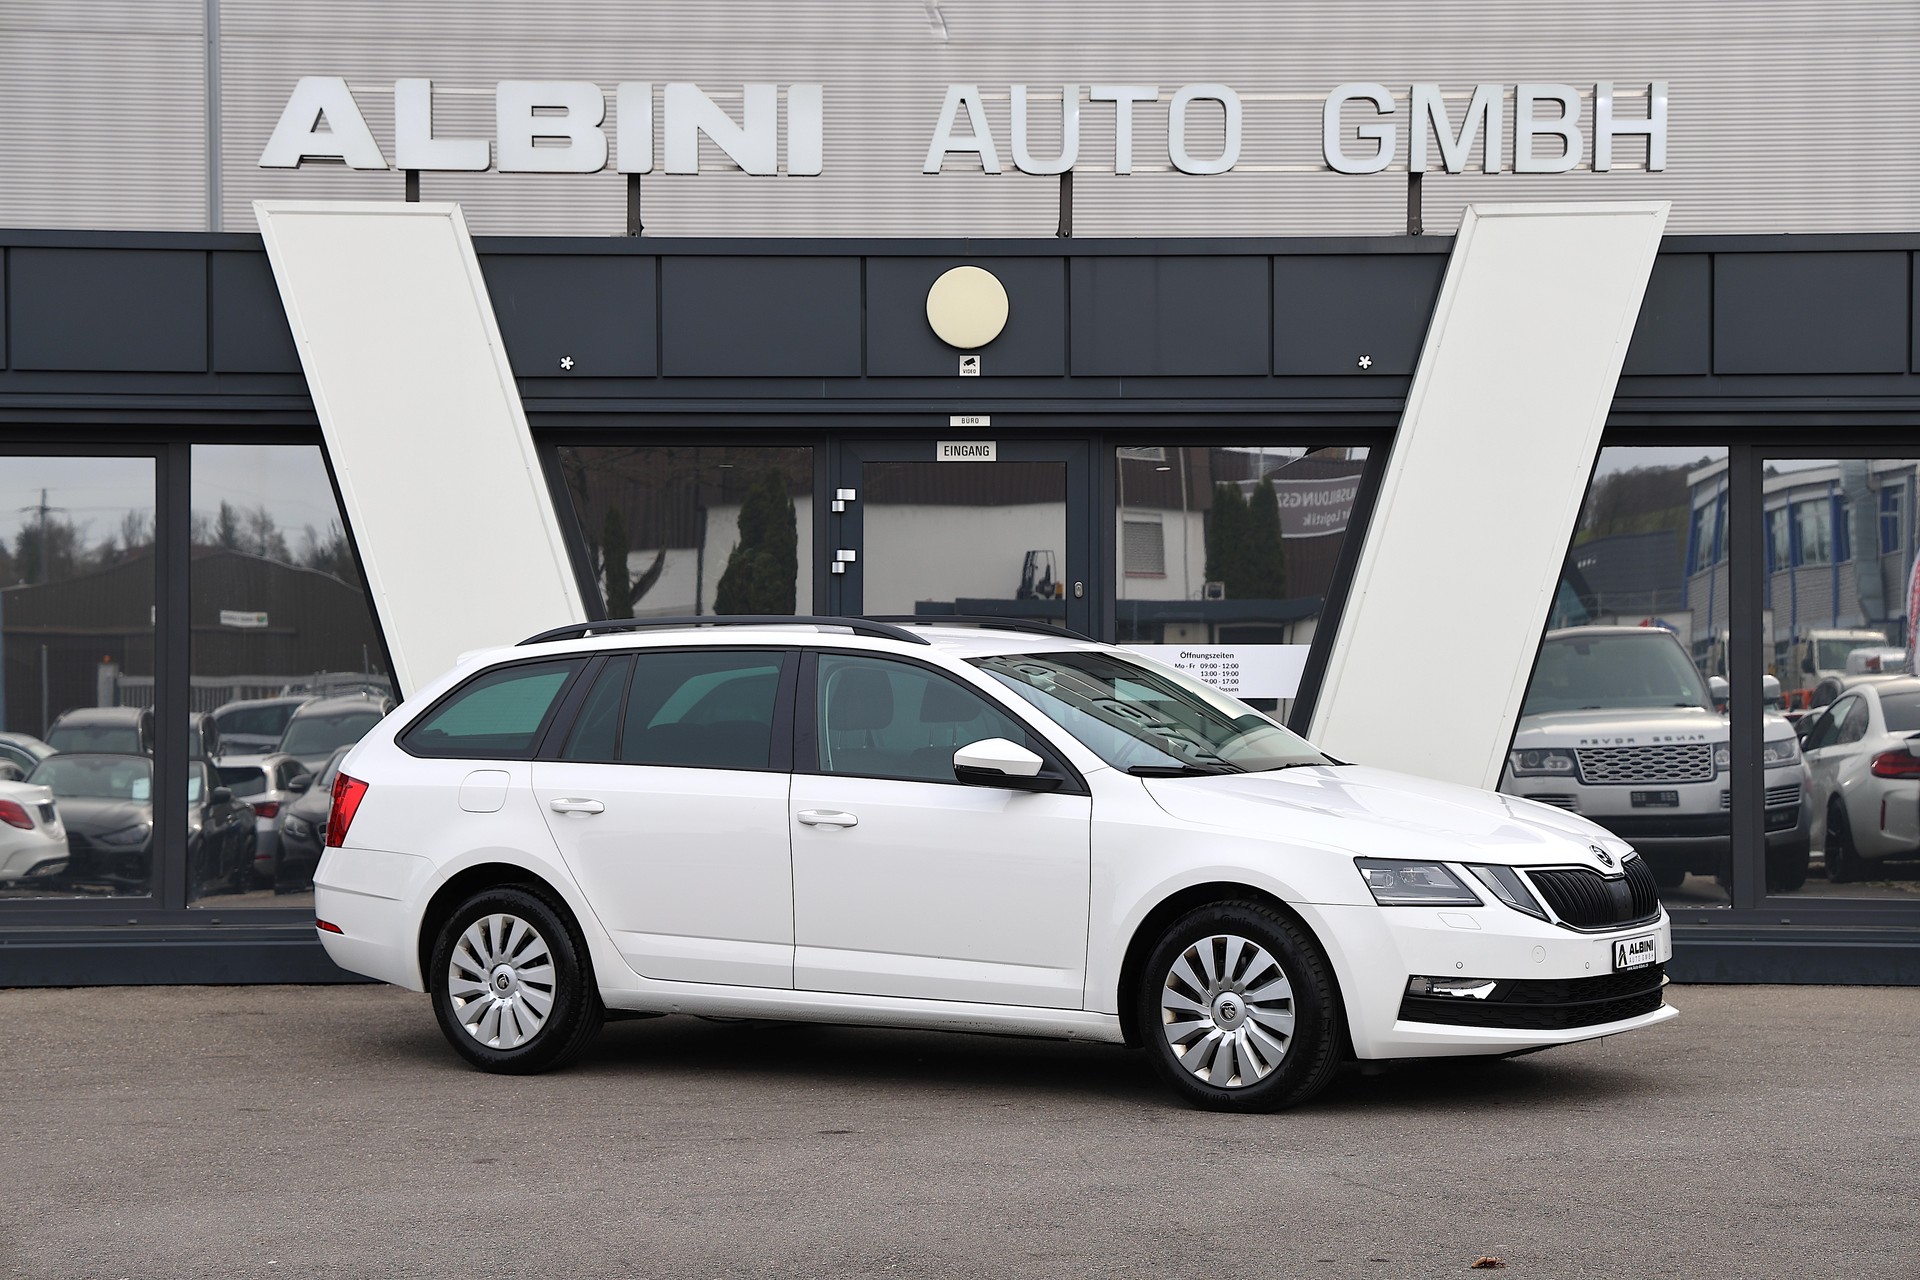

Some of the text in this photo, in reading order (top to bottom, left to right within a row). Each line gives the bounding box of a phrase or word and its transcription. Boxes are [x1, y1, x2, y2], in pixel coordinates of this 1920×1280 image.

[258, 76, 1669, 177] ALBINI AUTO GMBH
[944, 445, 990, 457] EINGANG
[1180, 651, 1235, 660] Öffnungszeiten
[1629, 939, 1654, 956] ALBINI
